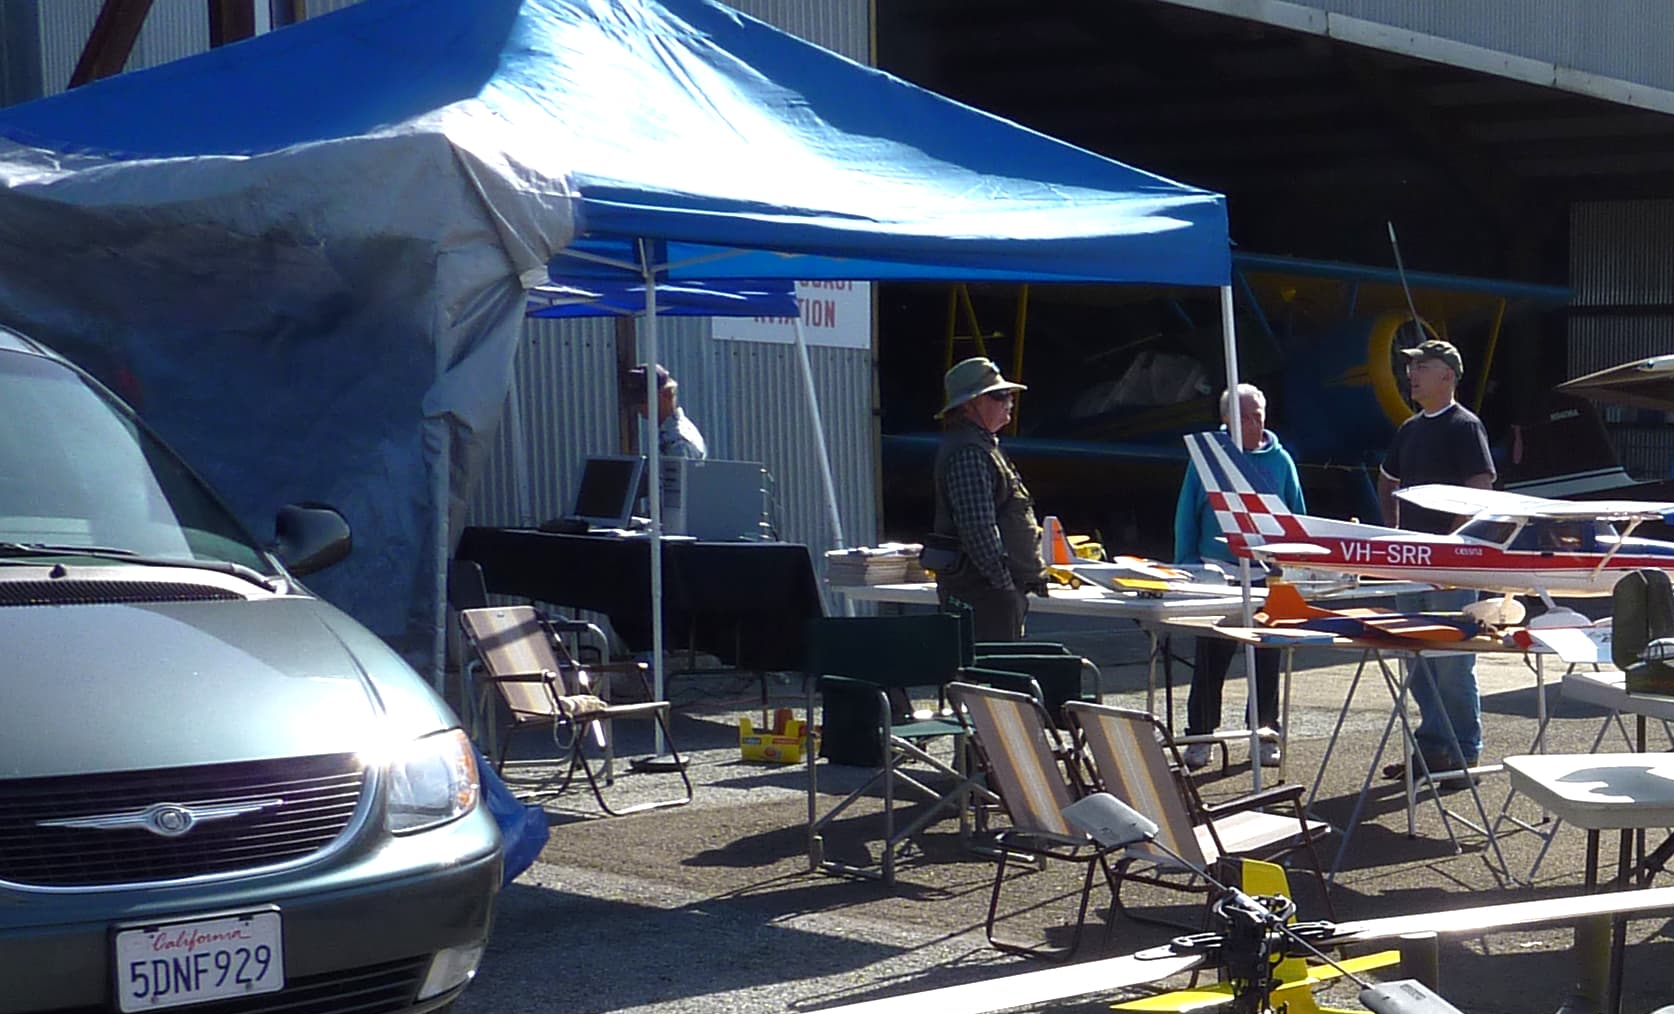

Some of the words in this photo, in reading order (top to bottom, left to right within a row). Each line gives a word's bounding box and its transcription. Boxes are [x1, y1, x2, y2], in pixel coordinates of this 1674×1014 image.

[1340, 541, 1432, 566] VH-SRR
[152, 928, 251, 952] California
[130, 944, 272, 999] 5DNF929
